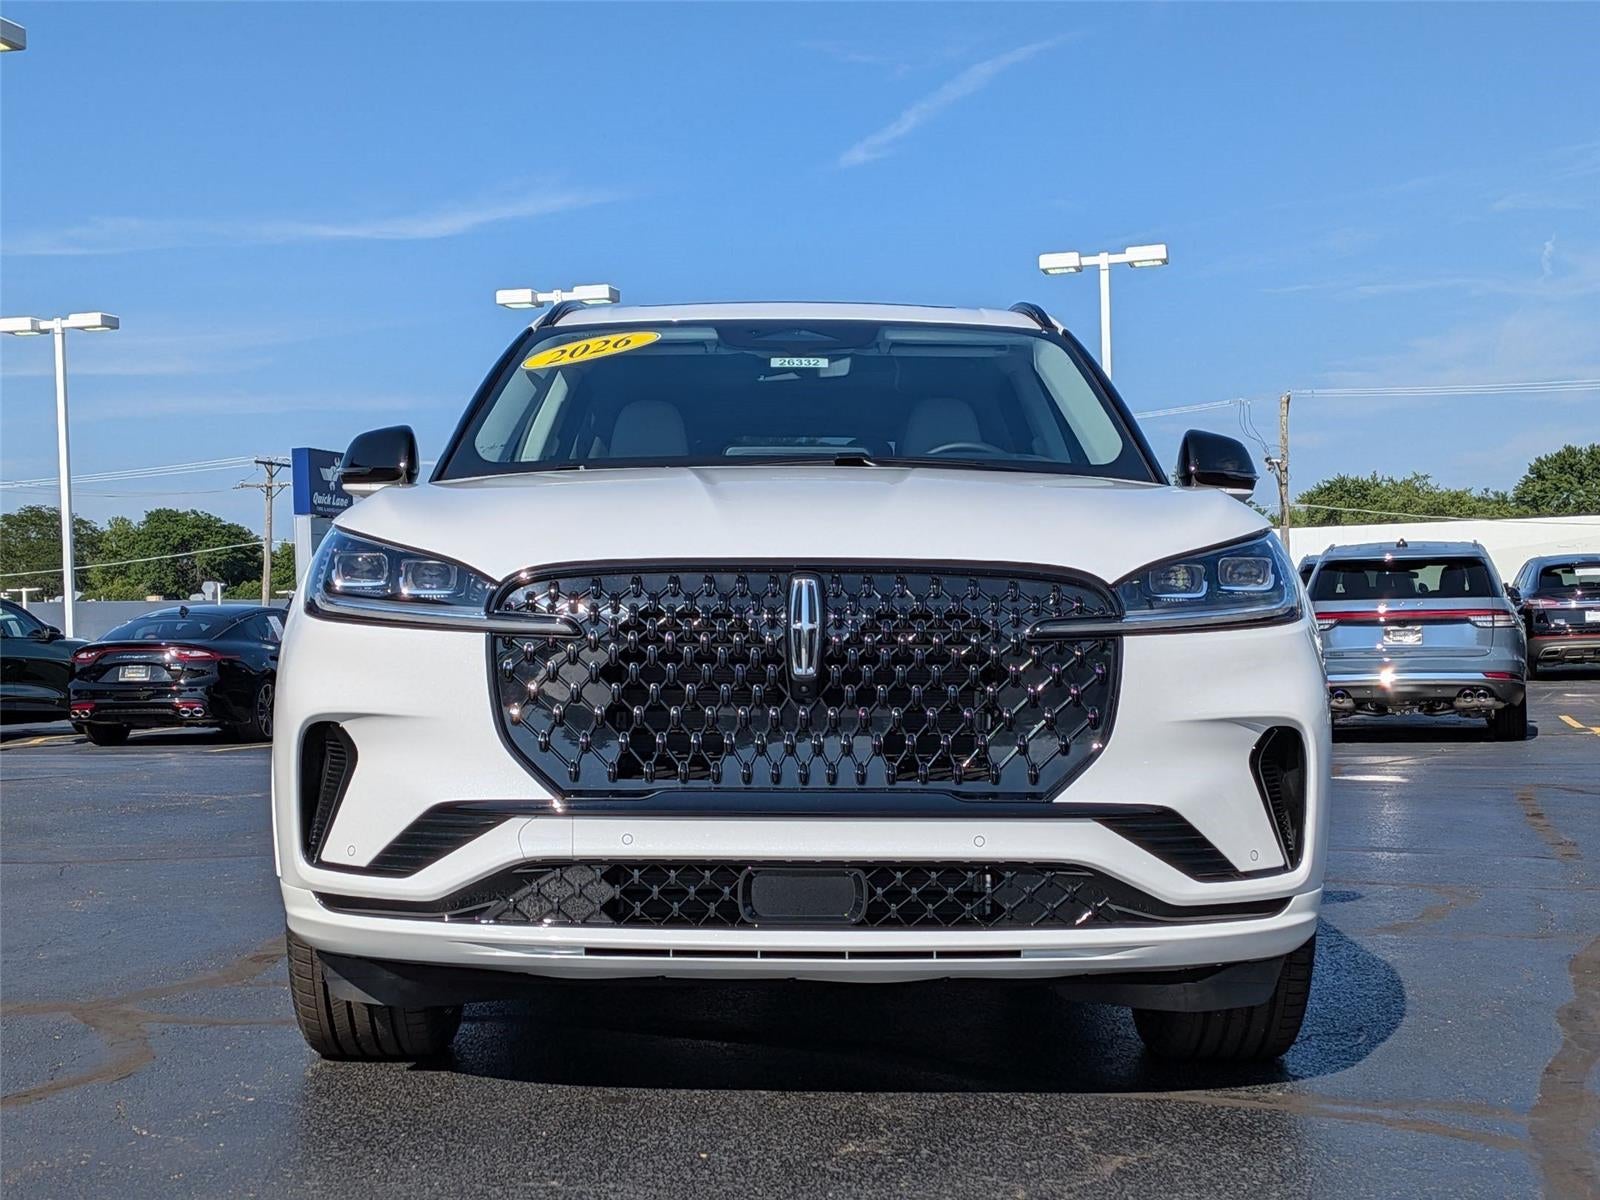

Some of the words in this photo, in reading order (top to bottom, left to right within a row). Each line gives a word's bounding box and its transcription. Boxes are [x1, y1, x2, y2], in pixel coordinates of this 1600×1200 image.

[545, 335, 632, 365] 2026
[312, 492, 331, 505] Quick
[331, 494, 348, 506] Lane
